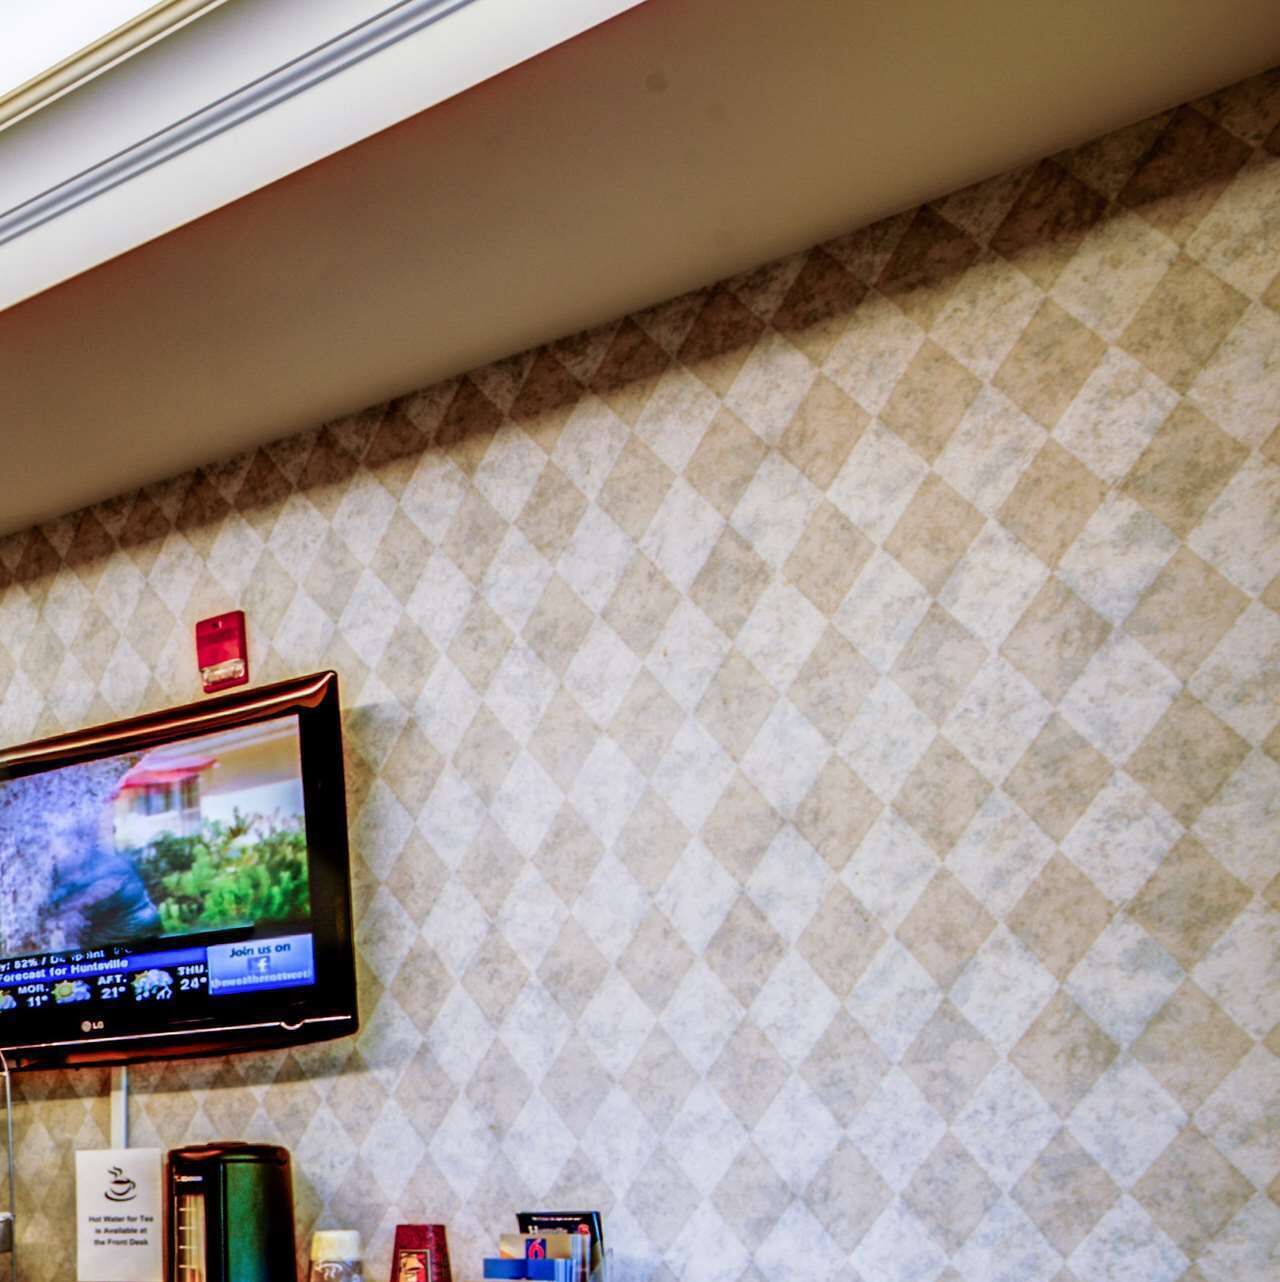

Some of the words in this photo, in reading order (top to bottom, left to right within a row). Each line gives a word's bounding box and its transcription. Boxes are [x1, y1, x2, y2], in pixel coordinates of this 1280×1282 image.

[230, 946, 254, 959] Join
[257, 944, 272, 955] us
[274, 943, 292, 953] on
[49, 965, 68, 977] for
[71, 958, 129, 975] Huntsville
[97, 973, 128, 986] AFT.
[18, 983, 50, 994] MOR.
[92, 1020, 105, 1030] LG
[88, 1215, 102, 1223] Hot
[103, 1215, 126, 1223] Water
[140, 1215, 154, 1223] Tea
[103, 1227, 138, 1235] Available
[94, 1238, 106, 1246] the
[107, 1238, 128, 1246] Front
[129, 1238, 149, 1246] Desk
